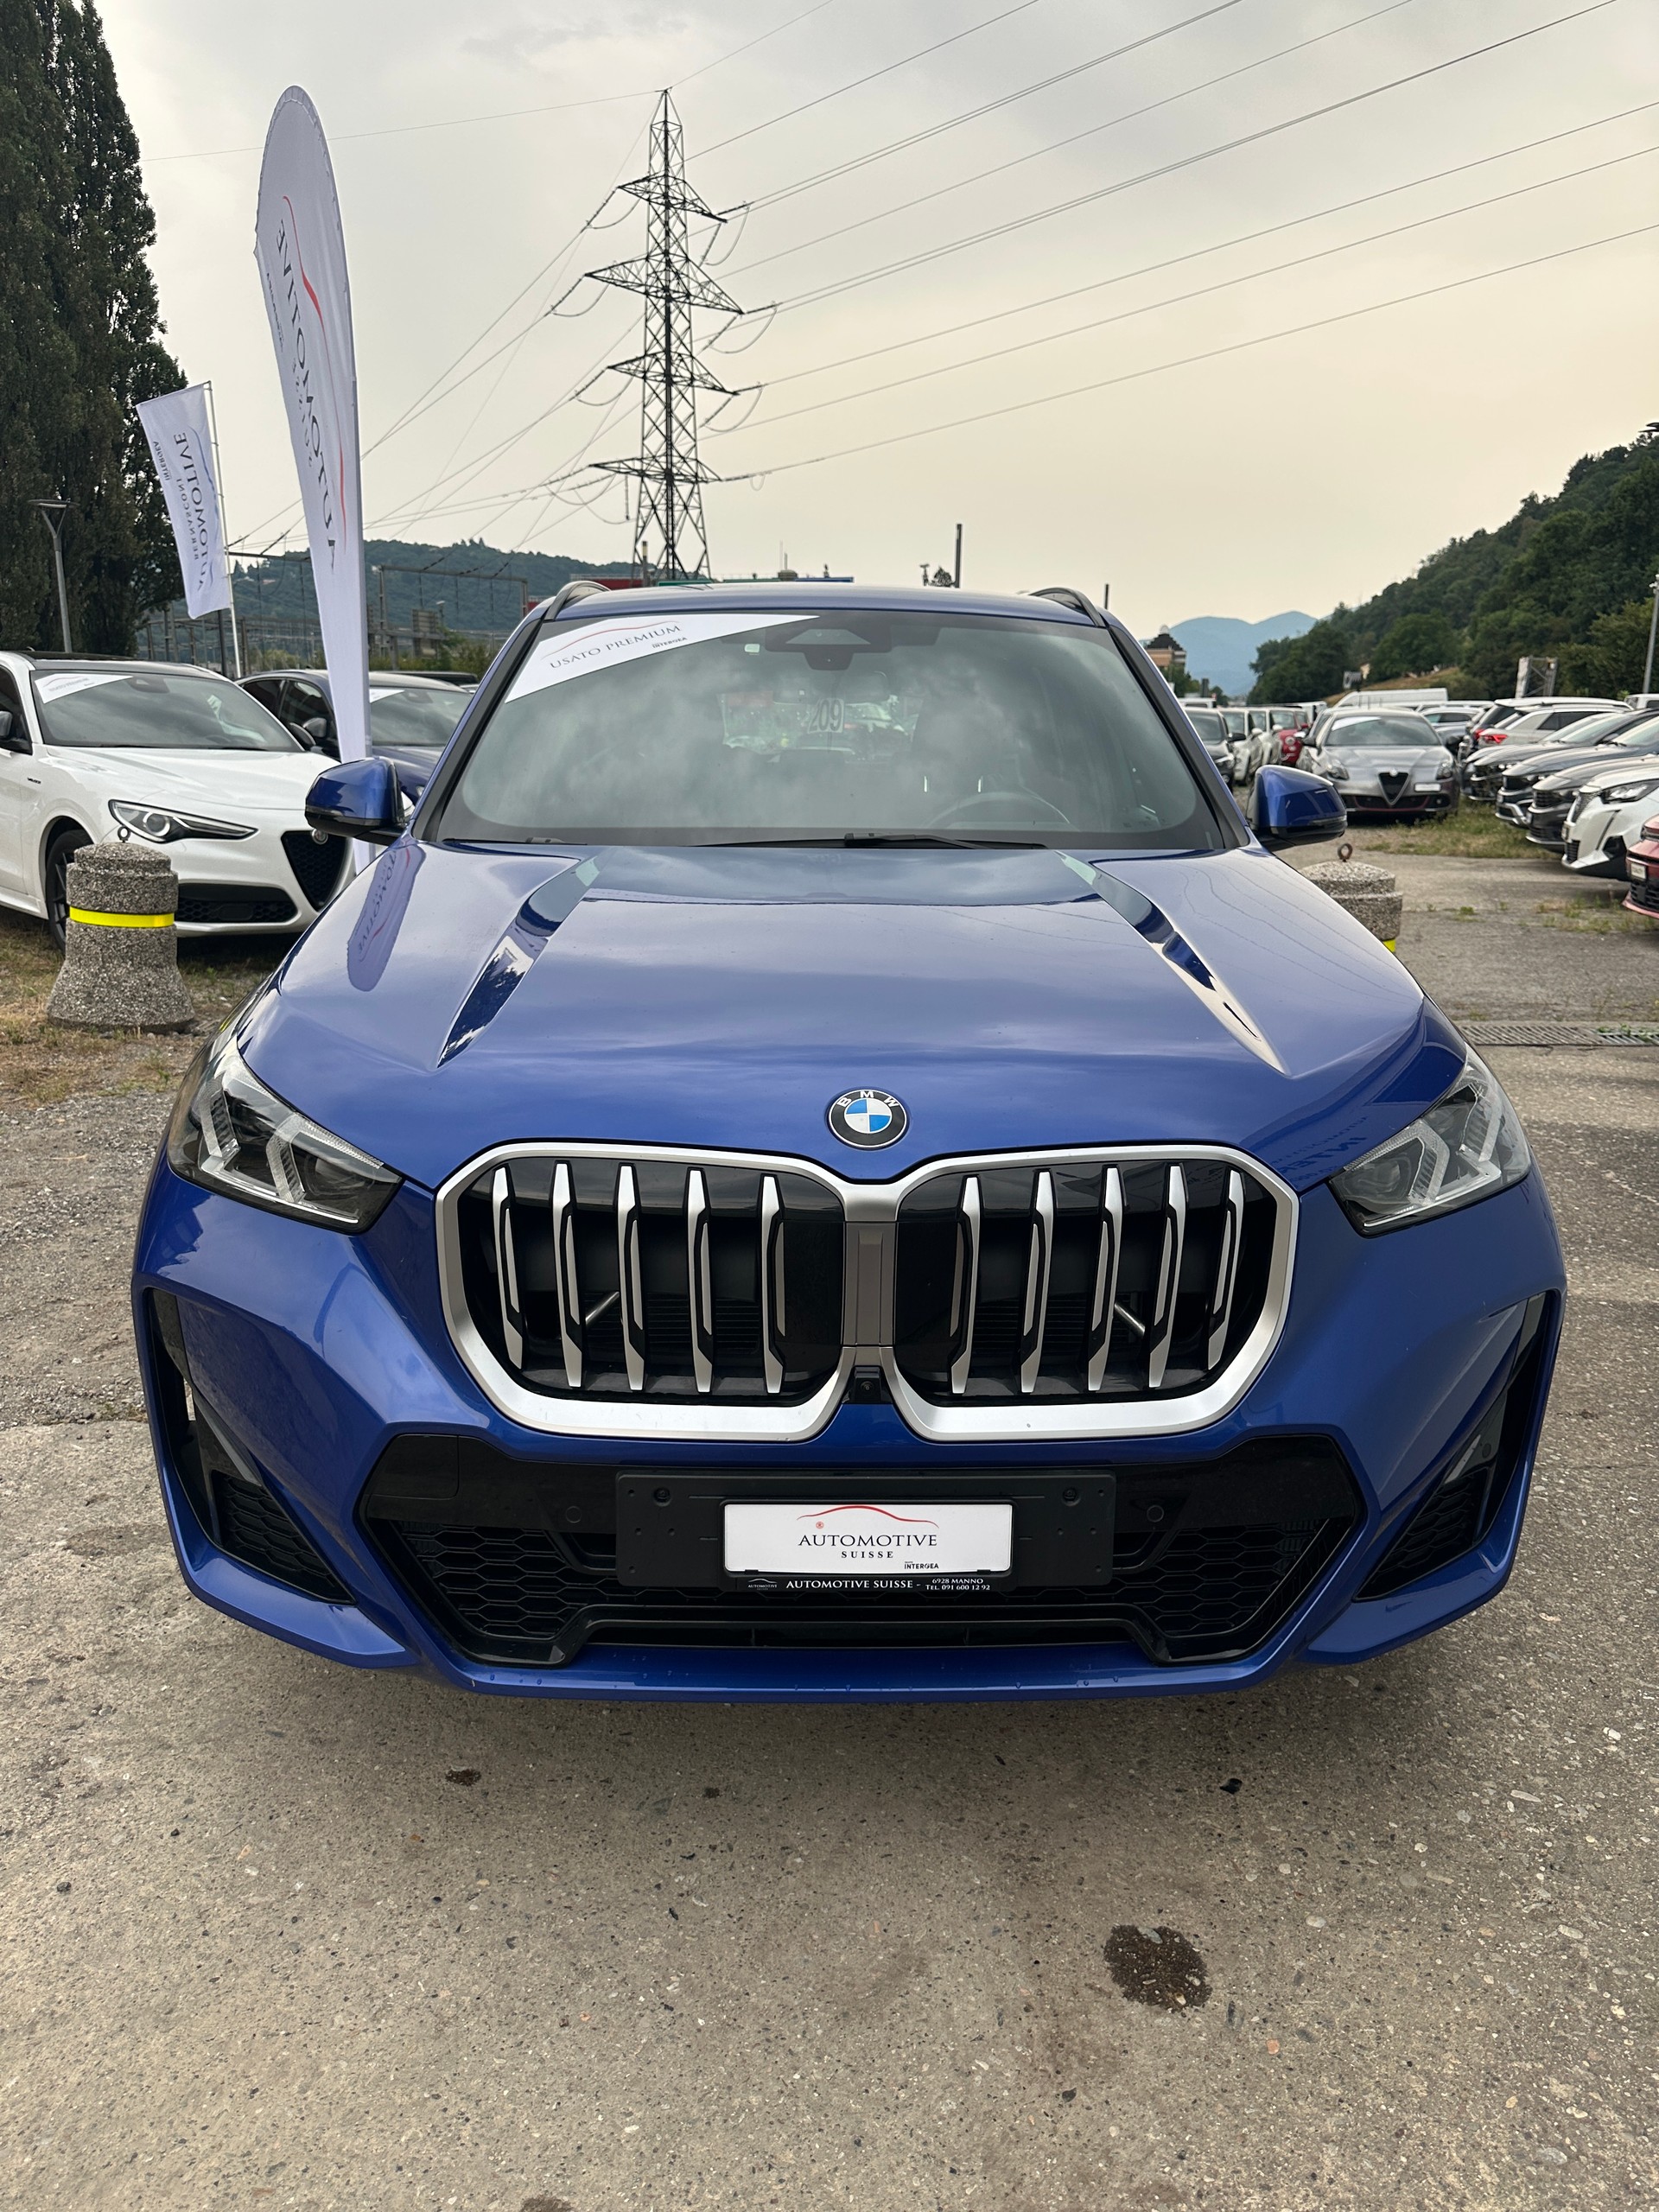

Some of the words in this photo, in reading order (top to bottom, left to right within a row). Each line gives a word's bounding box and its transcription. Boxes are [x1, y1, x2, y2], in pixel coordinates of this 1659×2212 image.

[550, 647, 601, 669] USATO
[606, 626, 681, 651] PREMIUM
[836, 1090, 899, 1108] BMW
[798, 1535, 938, 1547] AUTOMOTIVE
[785, 1580, 870, 1589] AUTOMOTIVE
[873, 1580, 913, 1588] SUISSE
